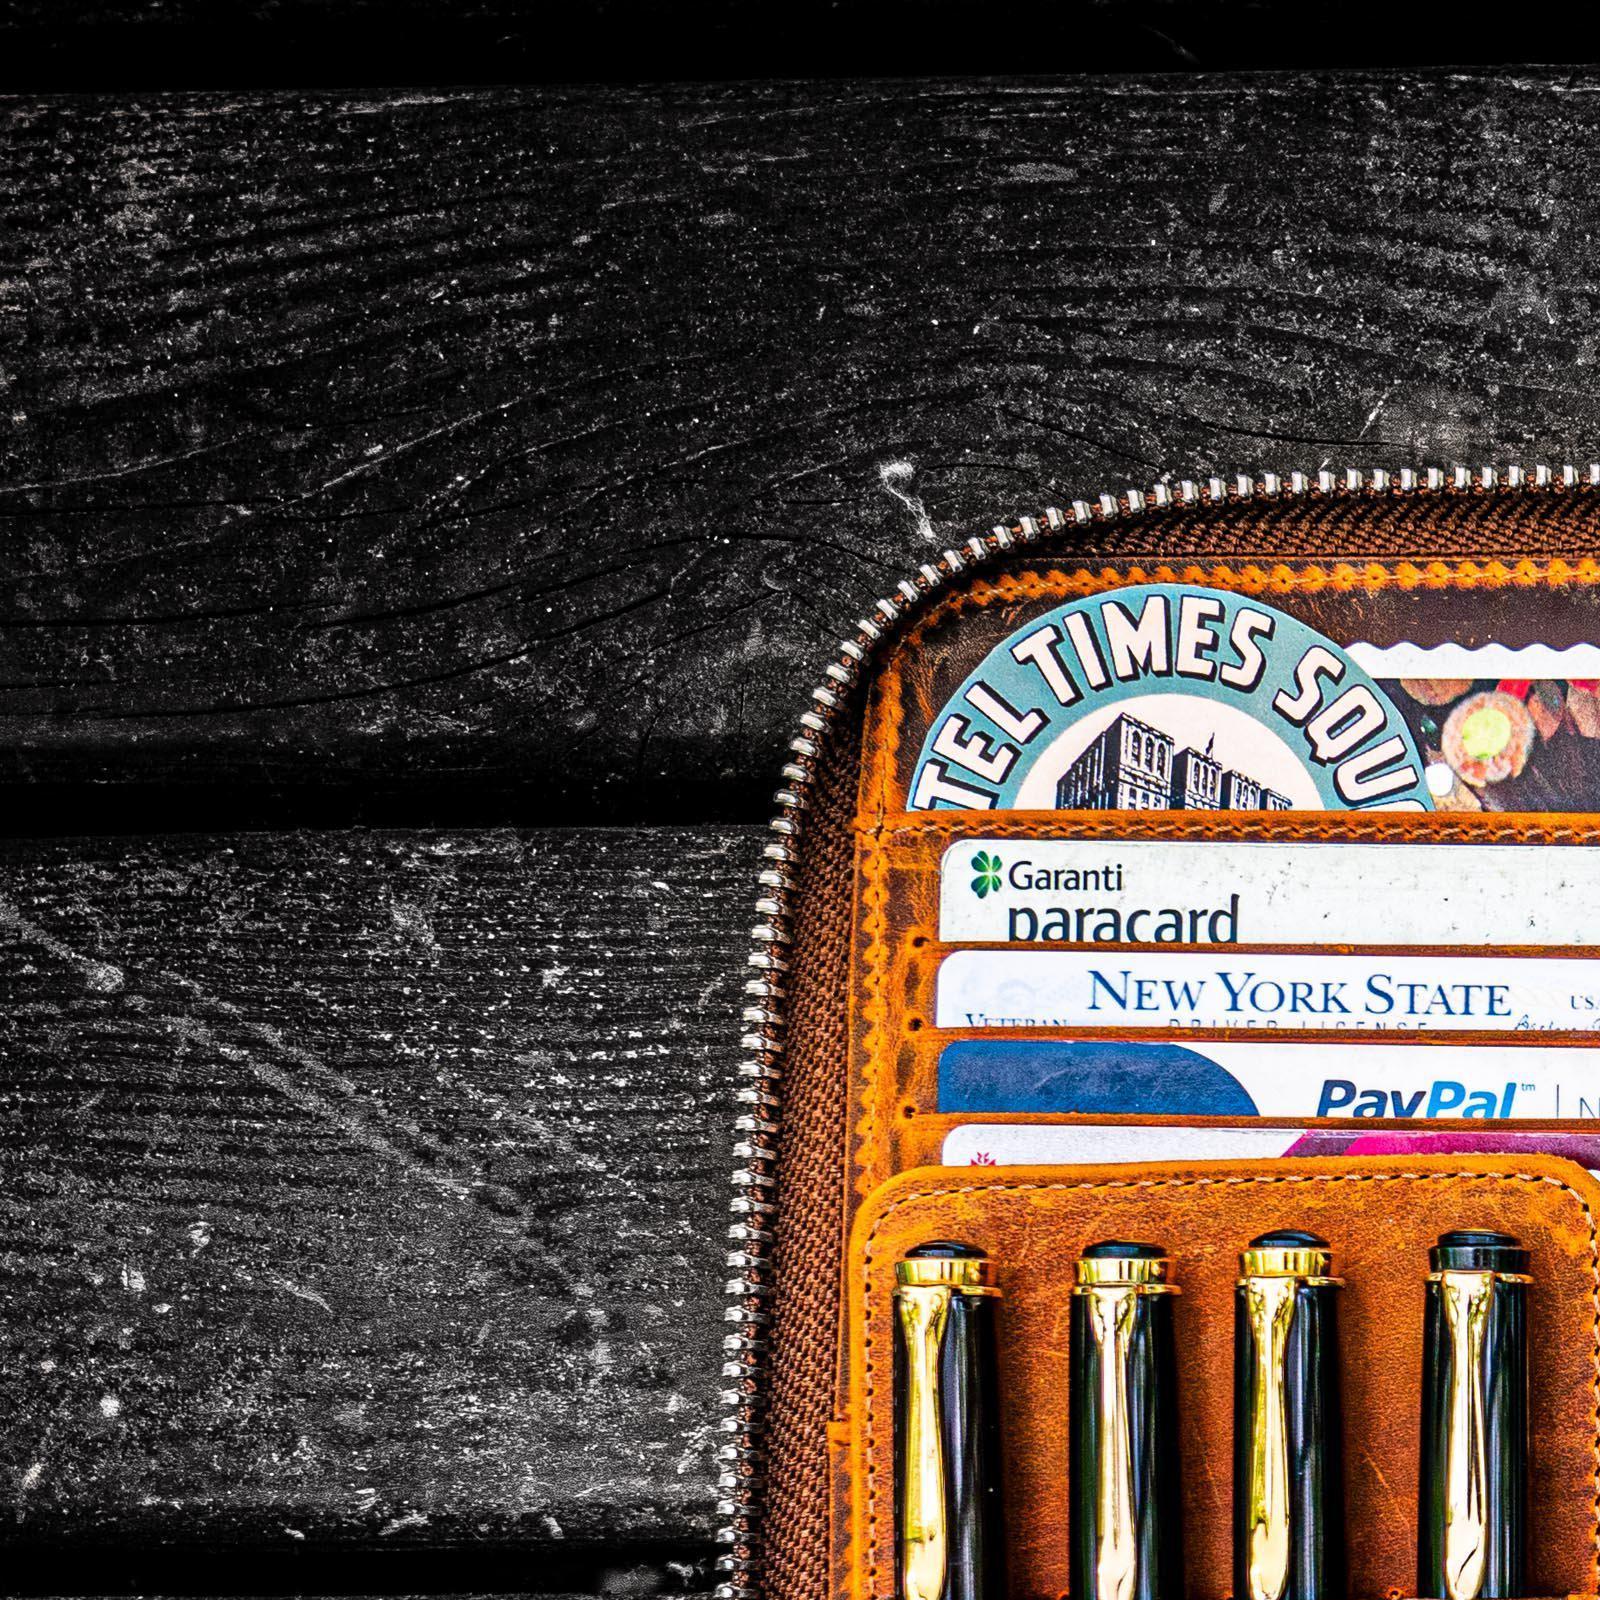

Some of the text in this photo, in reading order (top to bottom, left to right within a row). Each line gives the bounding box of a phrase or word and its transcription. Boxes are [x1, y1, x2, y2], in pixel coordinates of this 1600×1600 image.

[1009, 594, 1277, 707] TIMES
[1272, 644, 1428, 811] SQU
[1008, 860, 1123, 891] Garanti
[1008, 893, 1240, 943] paracard
